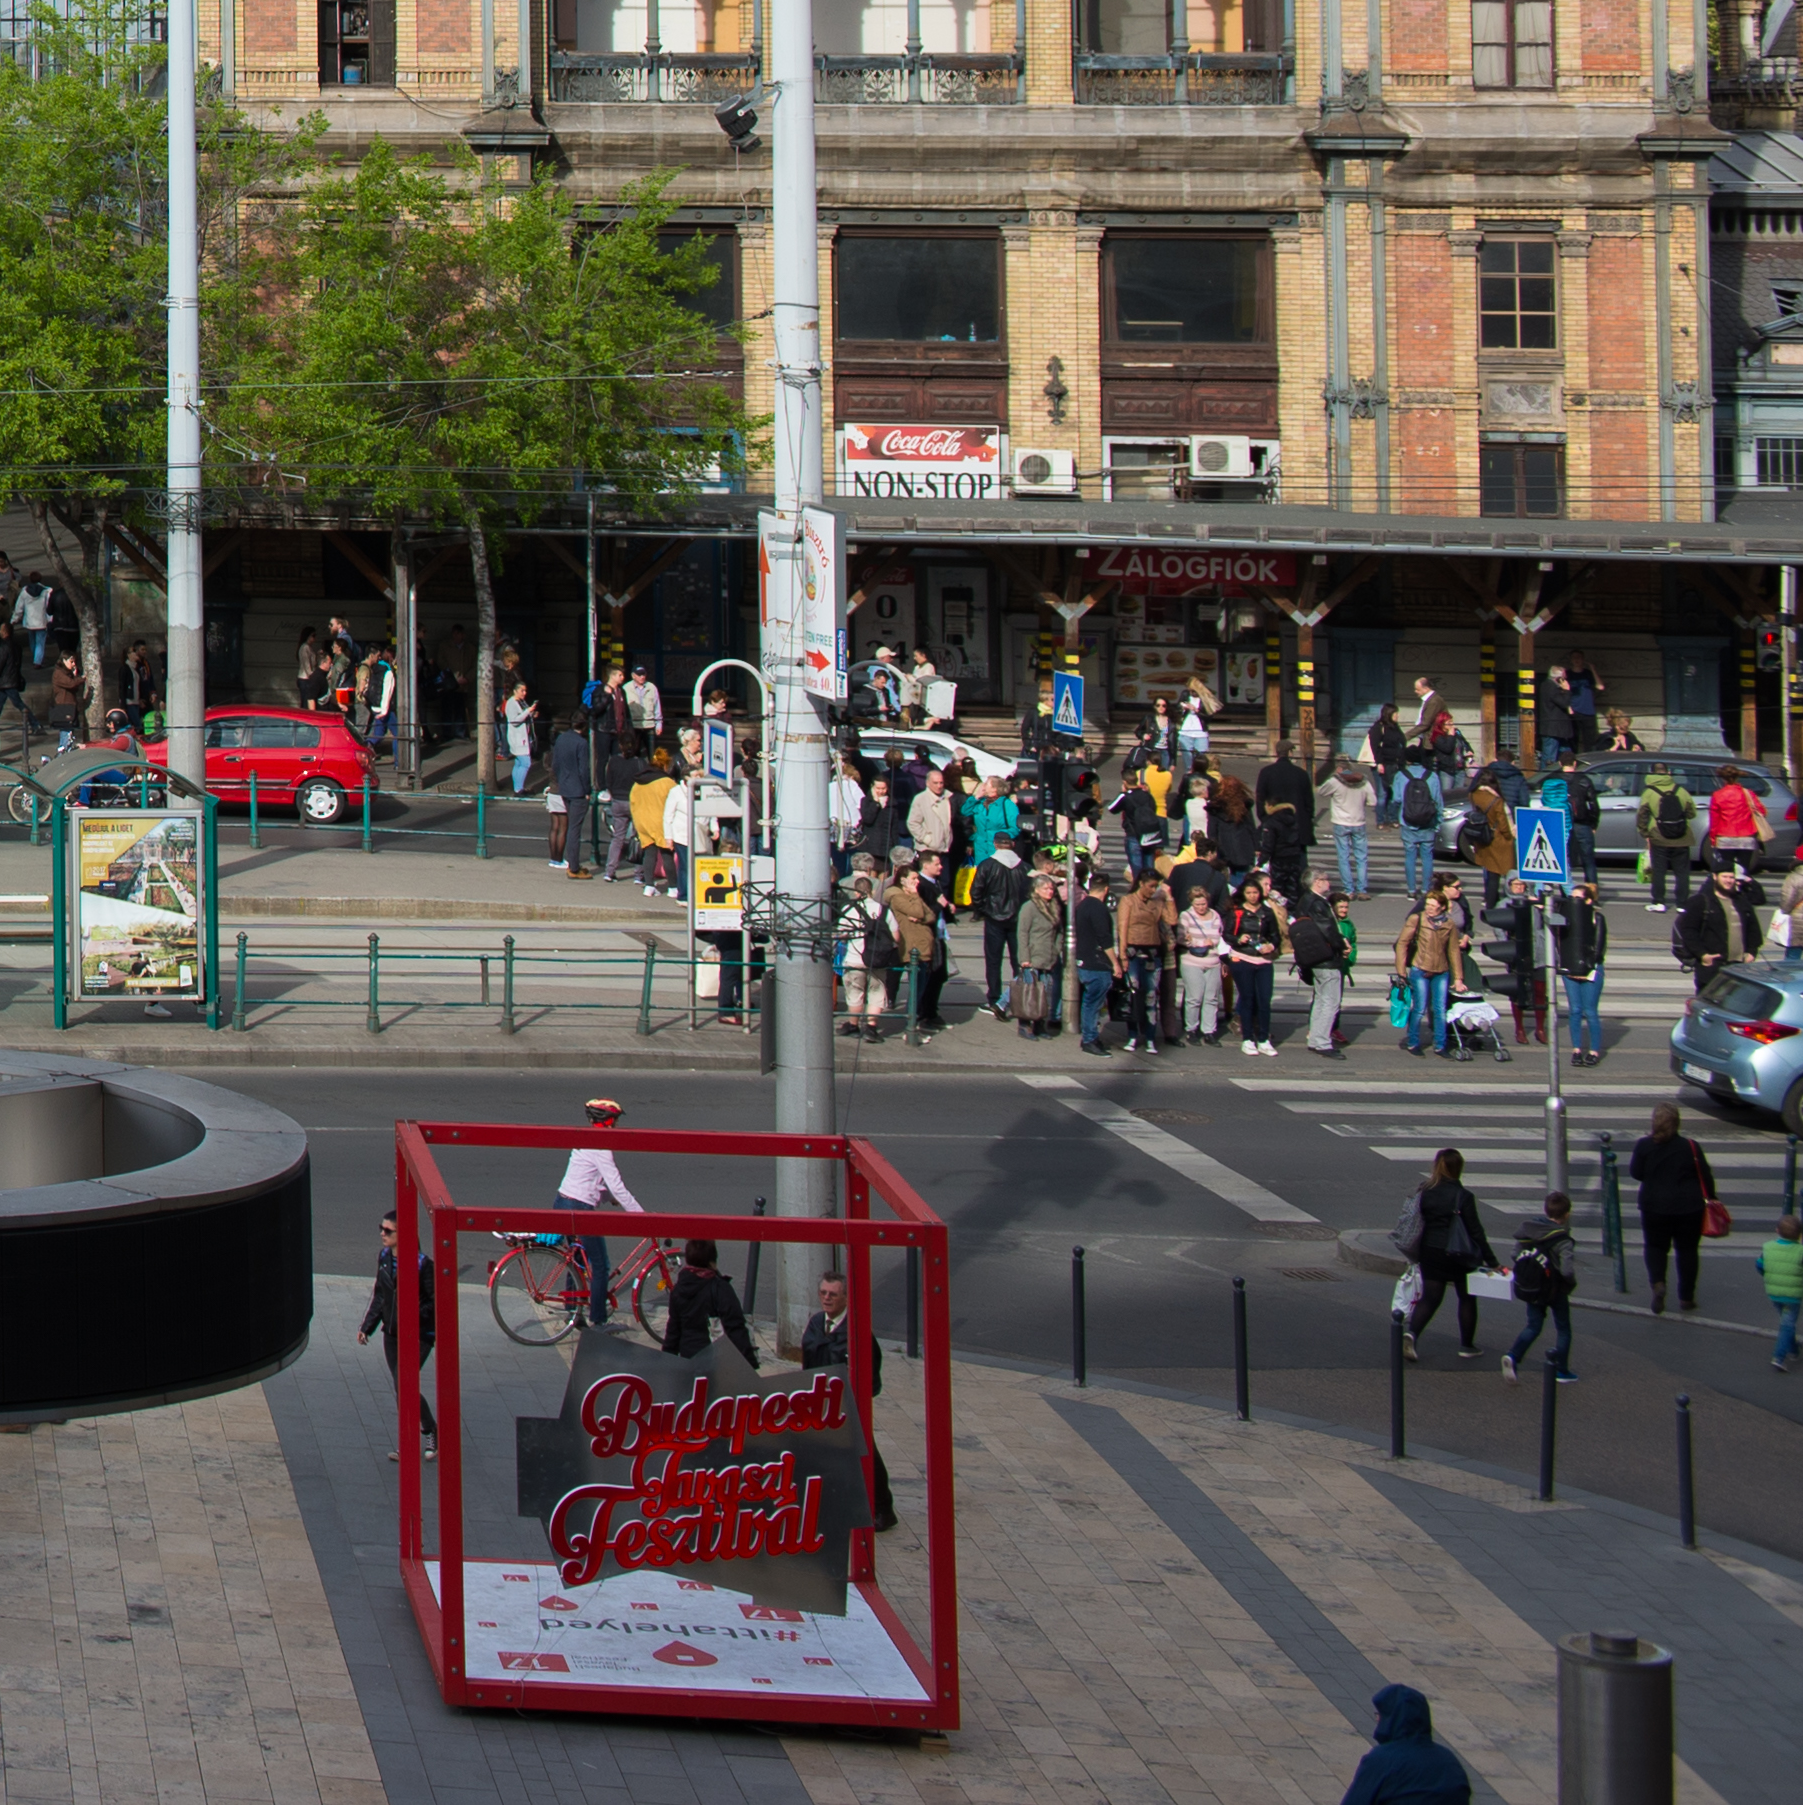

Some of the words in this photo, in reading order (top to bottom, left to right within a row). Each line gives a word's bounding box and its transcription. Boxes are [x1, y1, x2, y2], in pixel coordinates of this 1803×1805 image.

[881, 429, 965, 456] Coca-Cola
[854, 471, 992, 499] NON-STOP
[805, 519, 830, 568] Bisztró
[1097, 547, 1278, 582] ZÁLOGFIÓK
[876, 595, 897, 619] 0
[581, 1373, 846, 1458] Budapesti
[630, 1440, 798, 1518] Tavaszi
[749, 1609, 786, 1620] 17
[539, 1617, 802, 1642] #ittahelyed
[507, 1658, 550, 1670] 17
